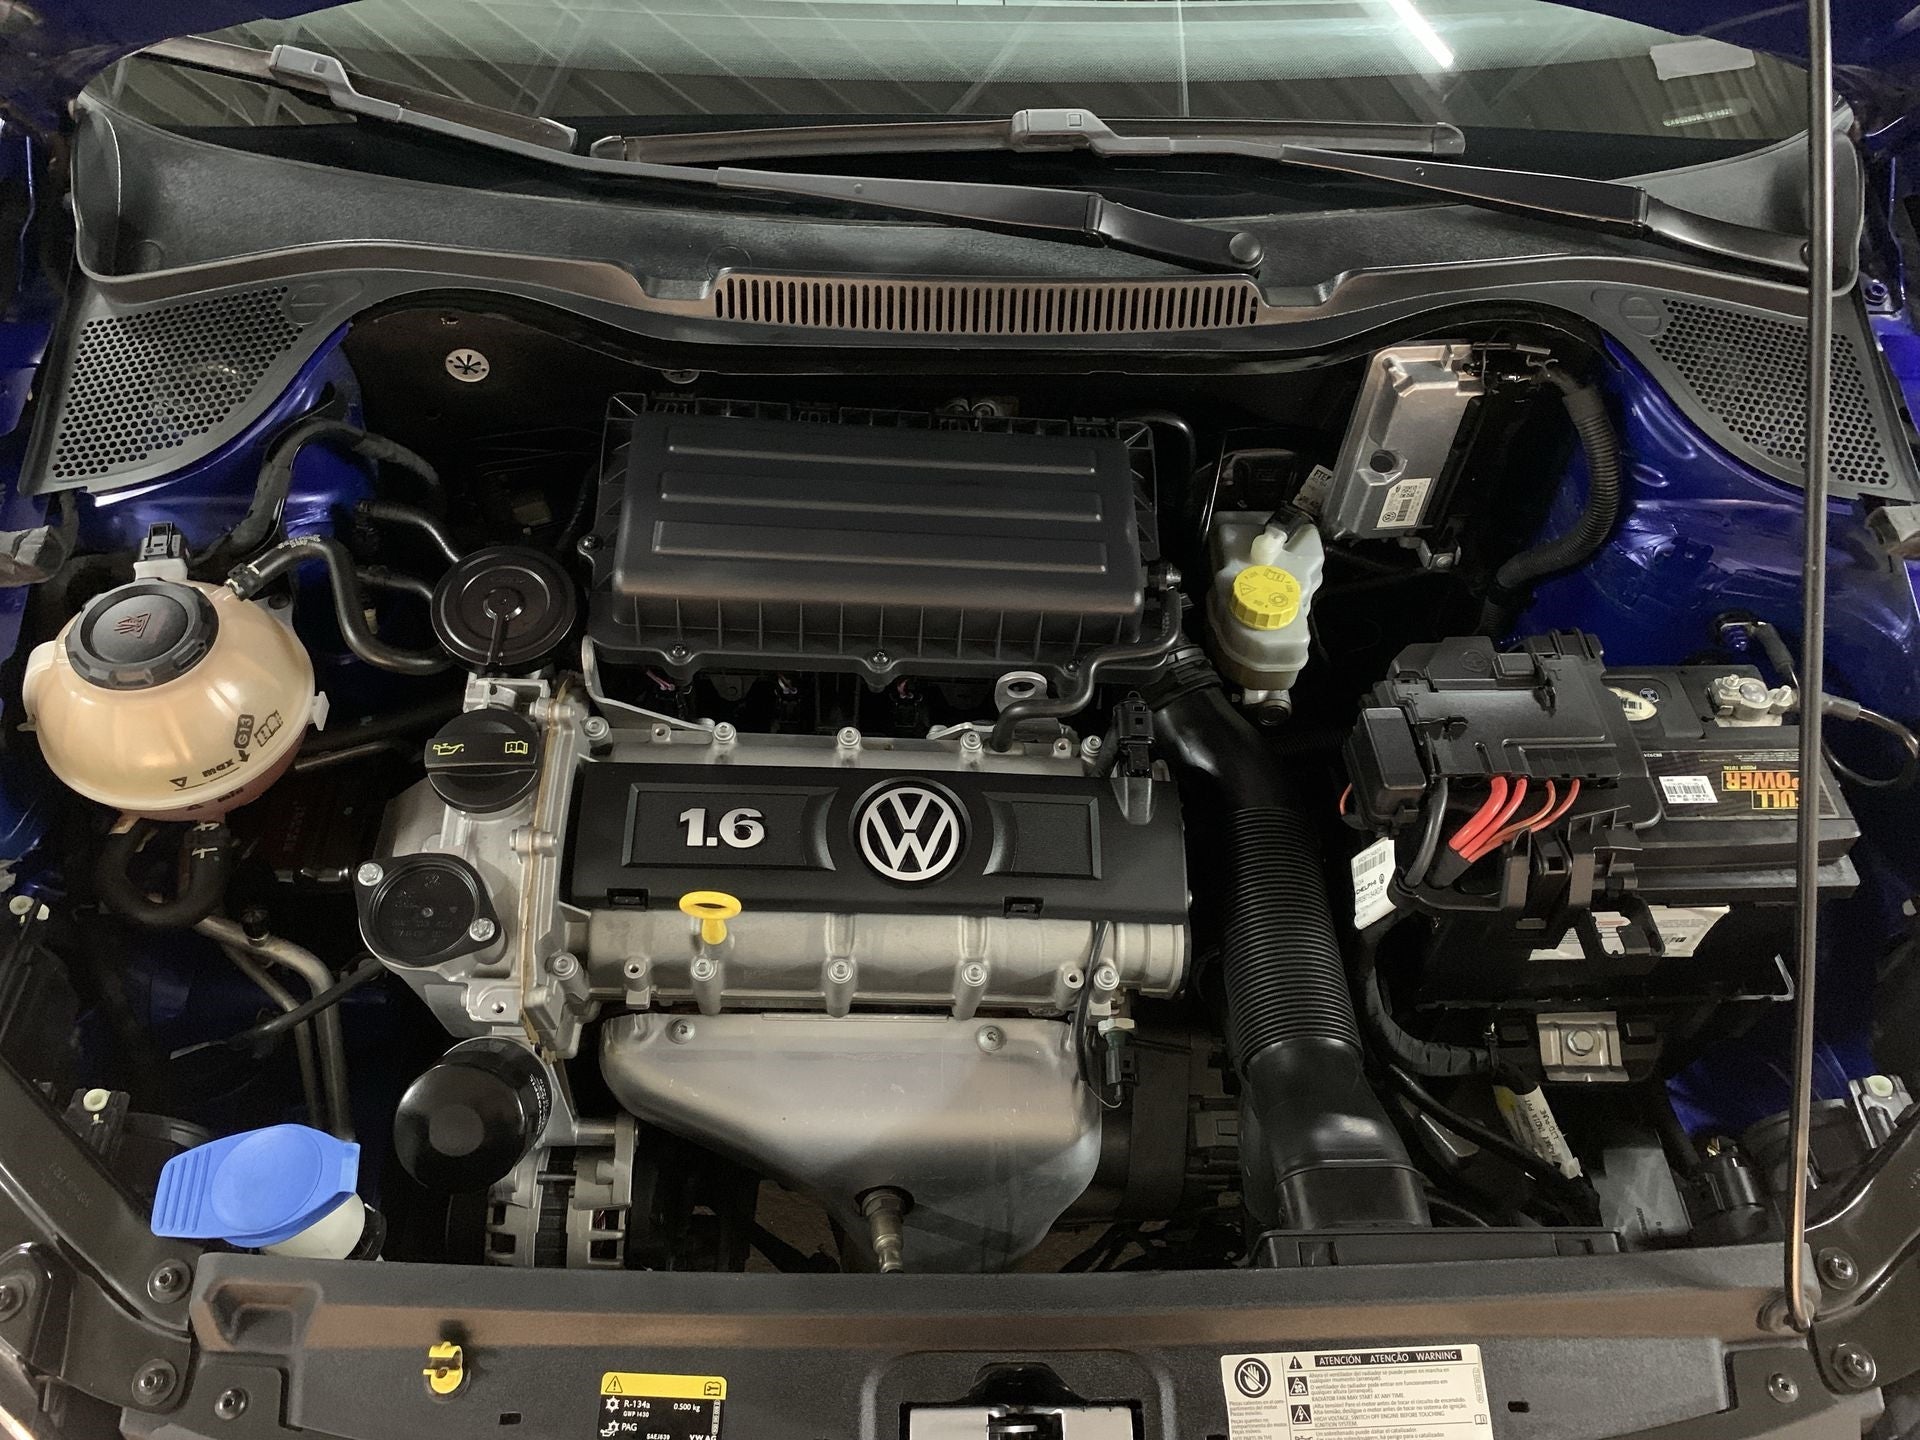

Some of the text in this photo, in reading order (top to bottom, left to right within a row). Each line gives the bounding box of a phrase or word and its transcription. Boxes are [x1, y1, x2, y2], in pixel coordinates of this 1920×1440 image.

[202, 758, 235, 777] max
[1756, 790, 1799, 809] ULL
[679, 807, 765, 849] 1.6
[1319, 1354, 1362, 1366] ATENCIÓN
[1416, 1351, 1457, 1361] WARNING
[623, 1399, 701, 1413] R-134a 0.500 kg
[621, 1422, 638, 1432] PAG
